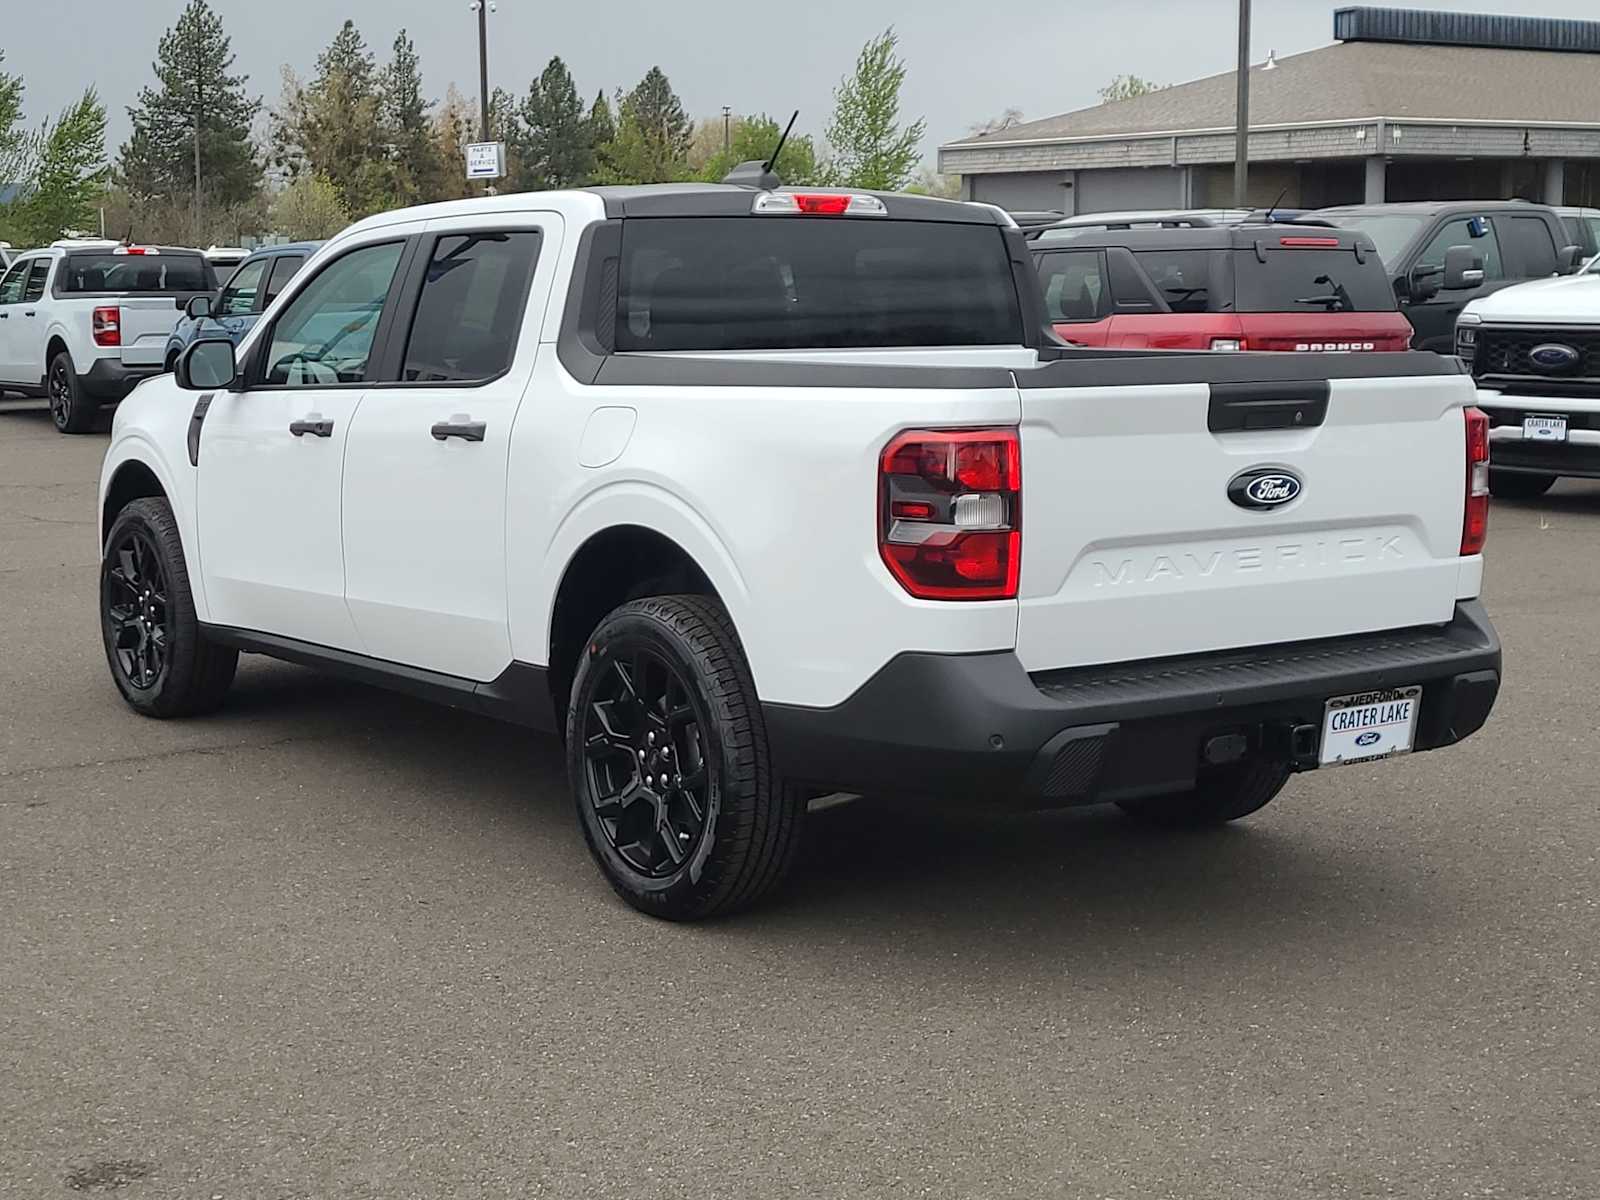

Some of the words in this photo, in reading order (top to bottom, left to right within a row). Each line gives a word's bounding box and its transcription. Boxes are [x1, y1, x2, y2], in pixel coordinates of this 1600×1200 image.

[1296, 343, 1374, 351] BRONCO
[1257, 479, 1290, 499] Ford
[1093, 535, 1403, 587] MAVERICK
[1350, 690, 1399, 706] MEDFORD
[1332, 708, 1378, 730] CRATER
[1380, 702, 1410, 723] LAKE
